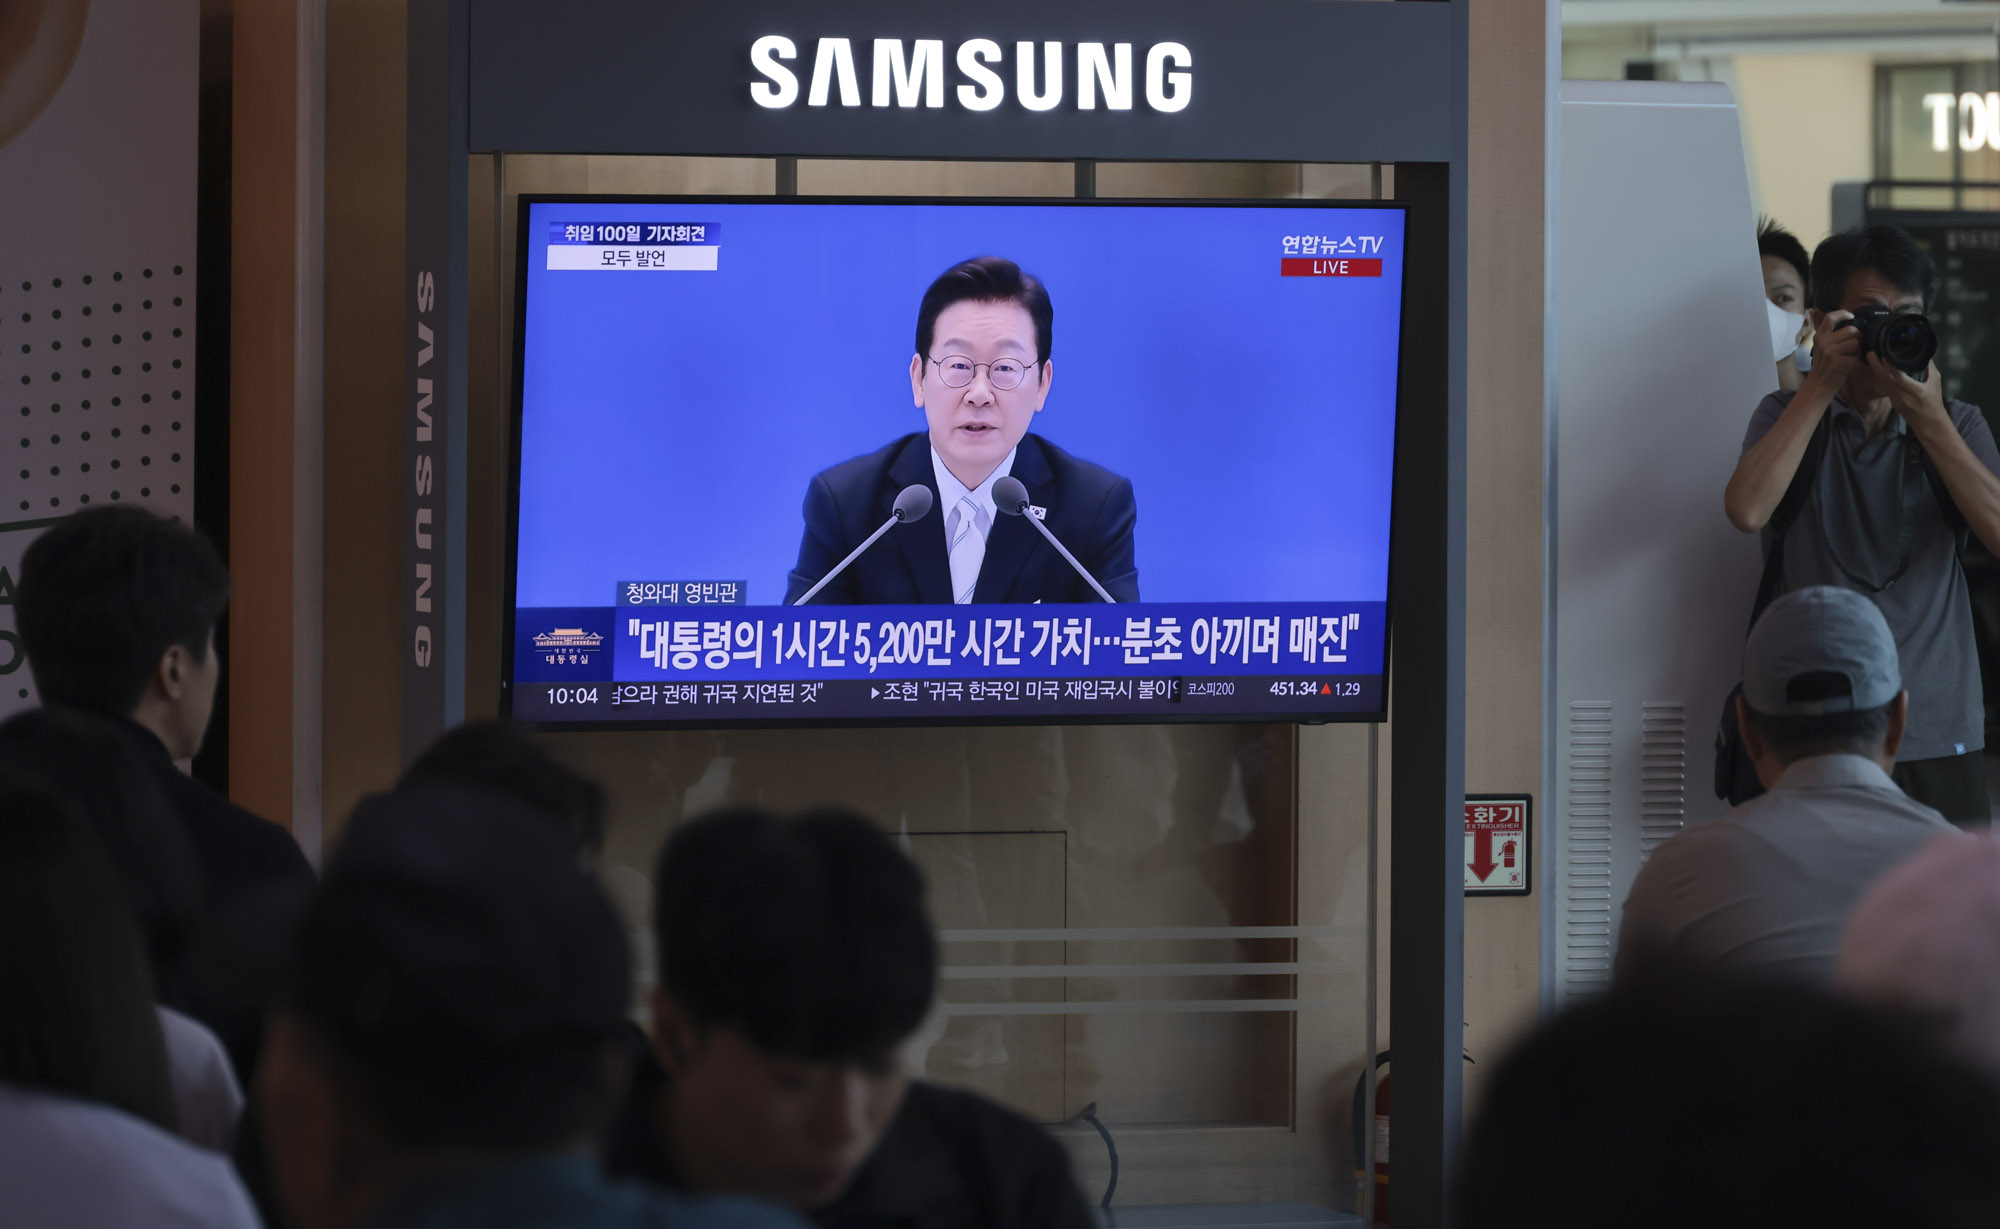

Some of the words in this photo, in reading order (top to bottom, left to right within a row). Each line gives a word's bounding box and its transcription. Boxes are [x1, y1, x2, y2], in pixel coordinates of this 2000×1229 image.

[750, 34, 1193, 113] SAMSUNG
[647, 225, 705, 242] 기자회견
[1282, 235, 1384, 255] 연합뉴스TV
[600, 250, 632, 267] 모두
[636, 250, 666, 267] 발언
[1313, 260, 1349, 274] LIVE
[414, 271, 435, 668] SAMSUNG
[626, 583, 679, 605] 청와대
[684, 582, 738, 604] 영빈관
[628, 618, 764, 670] "대통령의
[771, 619, 850, 668] 1시간
[854, 618, 956, 674] 5,200만
[960, 617, 1025, 667] 시간
[1190, 616, 1280, 665] 아끼며
[1289, 613, 1360, 664] 매진"
[545, 654, 589, 665] 대통령실
[547, 687, 599, 705] 10:04
[662, 684, 698, 705] 권해
[702, 684, 738, 704] 귀국
[743, 683, 795, 704] 지연된
[801, 682, 824, 703] 것"
[883, 681, 918, 702] 조현
[923, 681, 964, 702] "귀국
[968, 680, 1020, 701] 한국인
[1025, 680, 1060, 701] 미국
[1064, 679, 1133, 700] 재입국시
[1187, 682, 1235, 697] 코스피200
[1269, 681, 1318, 696] 451.34
[1335, 682, 1361, 697] 1.29
